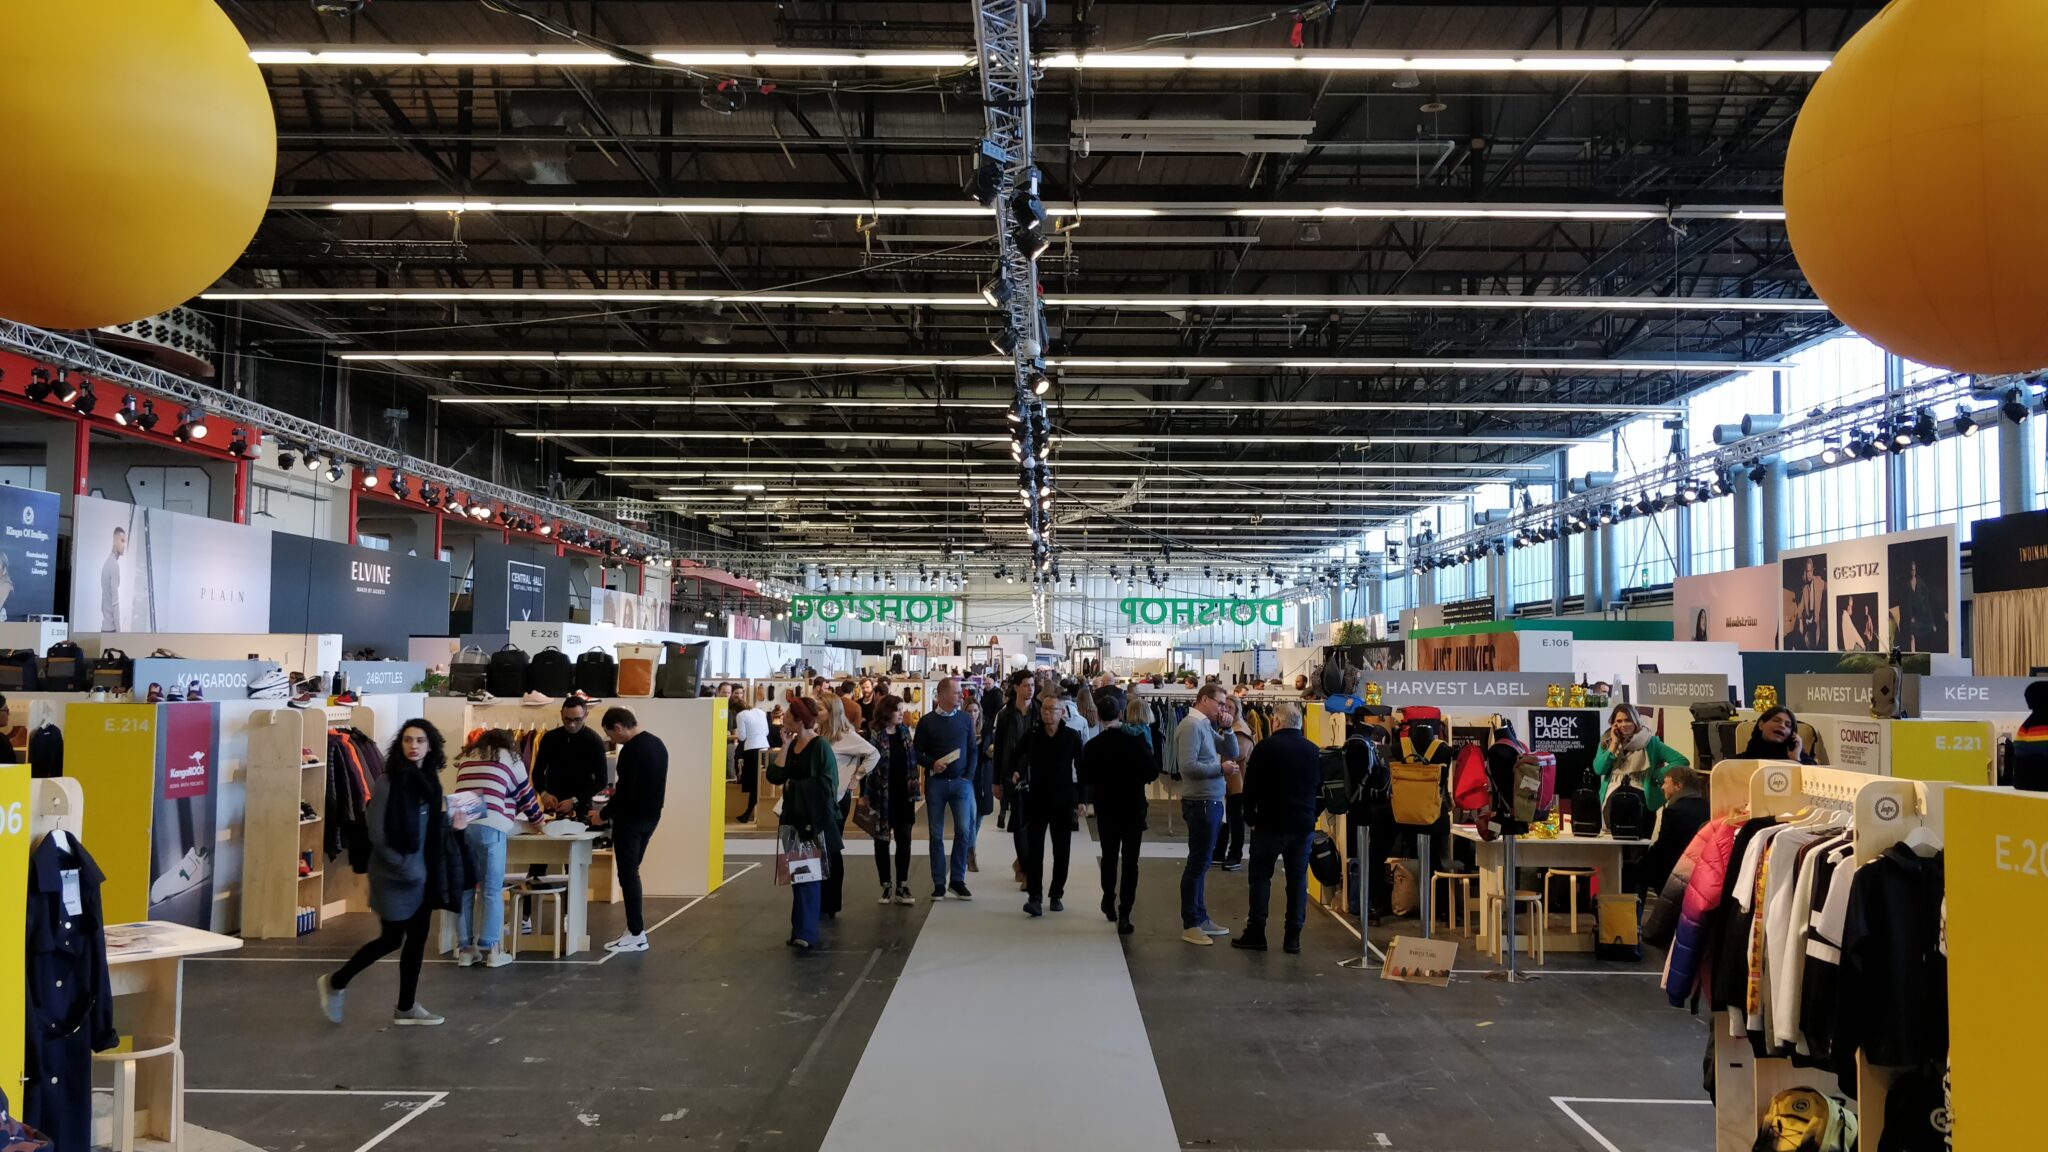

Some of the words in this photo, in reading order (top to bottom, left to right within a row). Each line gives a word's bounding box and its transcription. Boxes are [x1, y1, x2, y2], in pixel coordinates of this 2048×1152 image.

[351, 561, 391, 585] ELVINE
[511, 572, 531, 585] CENTRAL
[1833, 562, 1880, 580] GESTUZ
[200, 587, 245, 603] PLAIN
[531, 629, 559, 638] E.226
[1542, 638, 1569, 647] E.106
[177, 672, 247, 688] KANGAROOS
[366, 672, 403, 684] 24BOTTLES
[1386, 681, 1468, 696] HARVEST
[1473, 682, 1530, 697] LABEL
[1658, 683, 1688, 696] LEATHER
[1689, 684, 1714, 697] BOOTS
[1807, 686, 1851, 702] HARVEST
[1944, 684, 1990, 701] KÉPE
[104, 717, 149, 732] E.214
[1534, 716, 1578, 728] BLACK
[1534, 727, 1579, 739] LABEL.
[1840, 728, 1880, 745] CONNECT.
[1935, 735, 1982, 751] E.221
[169, 766, 205, 779] KangaROOS
